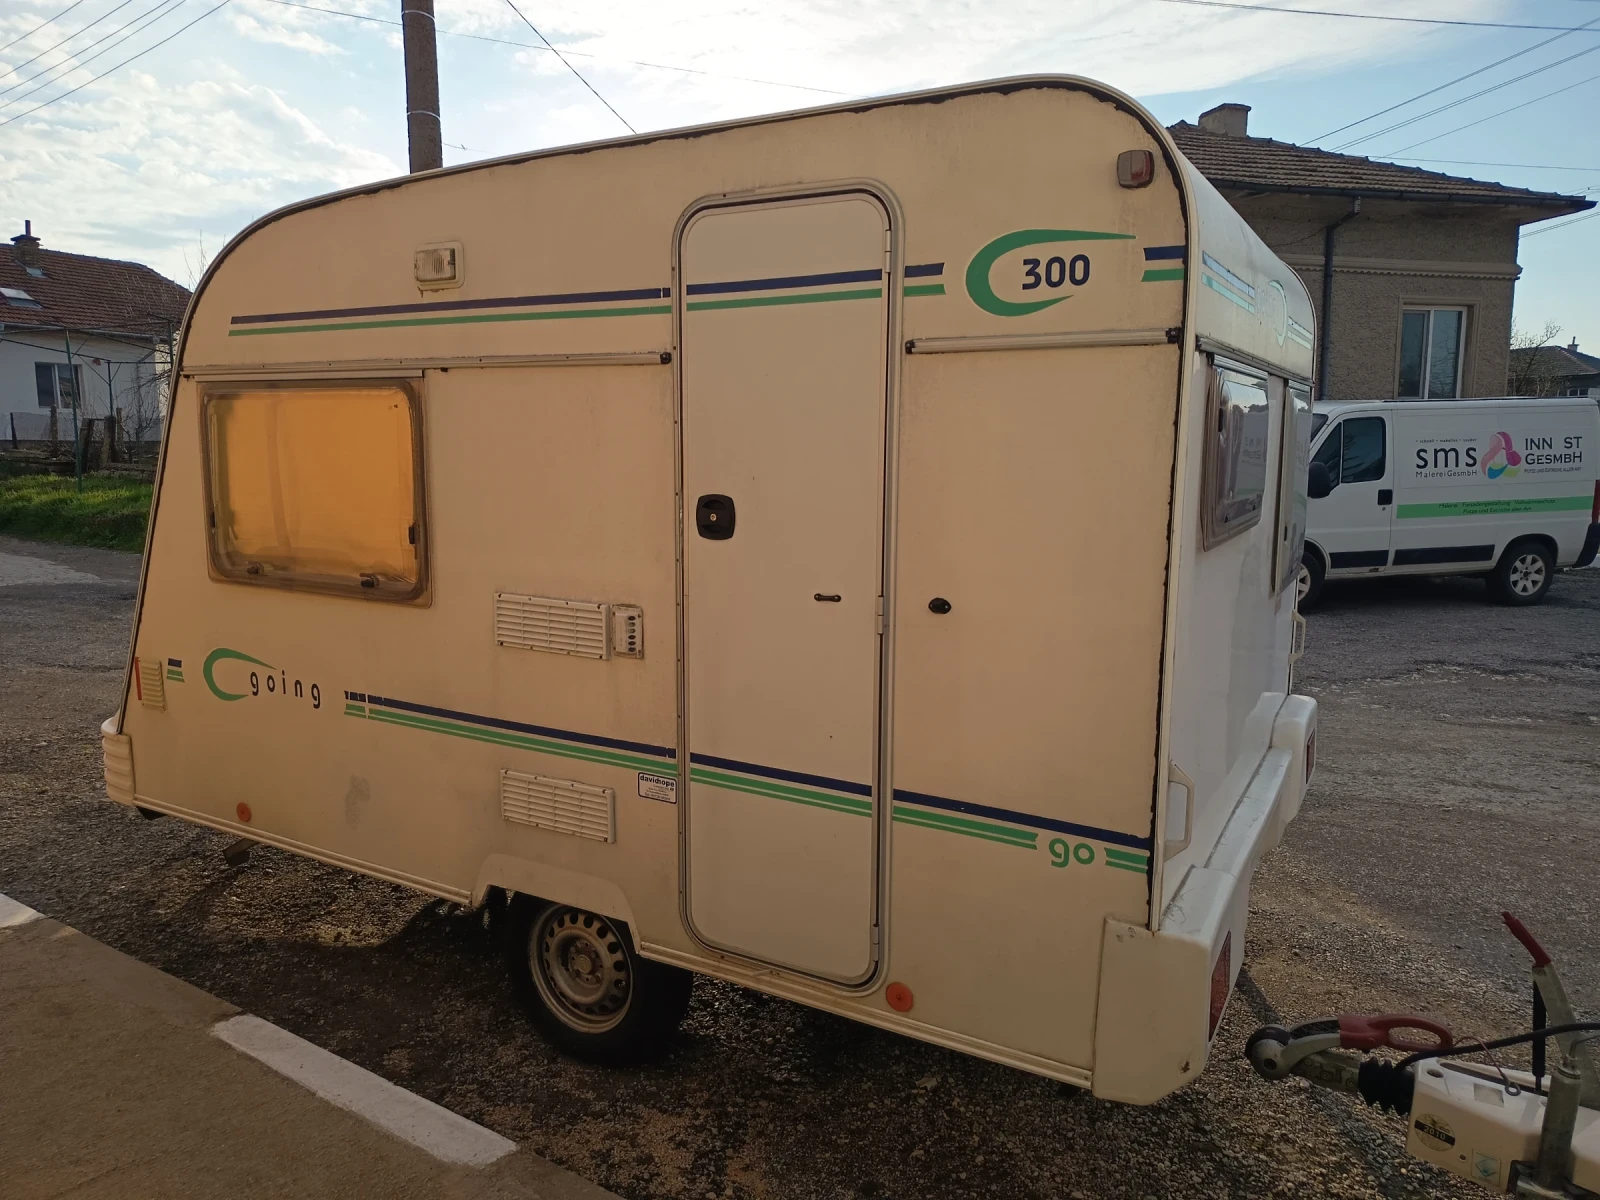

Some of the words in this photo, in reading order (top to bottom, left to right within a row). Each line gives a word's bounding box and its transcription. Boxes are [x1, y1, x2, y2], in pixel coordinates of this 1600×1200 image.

[1022, 254, 1090, 290] 300
[1525, 437, 1553, 450] INN
[1564, 436, 1582, 449] ST
[1416, 446, 1477, 469] sms
[250, 670, 321, 709] going
[1048, 837, 1095, 868] go
[1423, 1125, 1446, 1140] 2010
